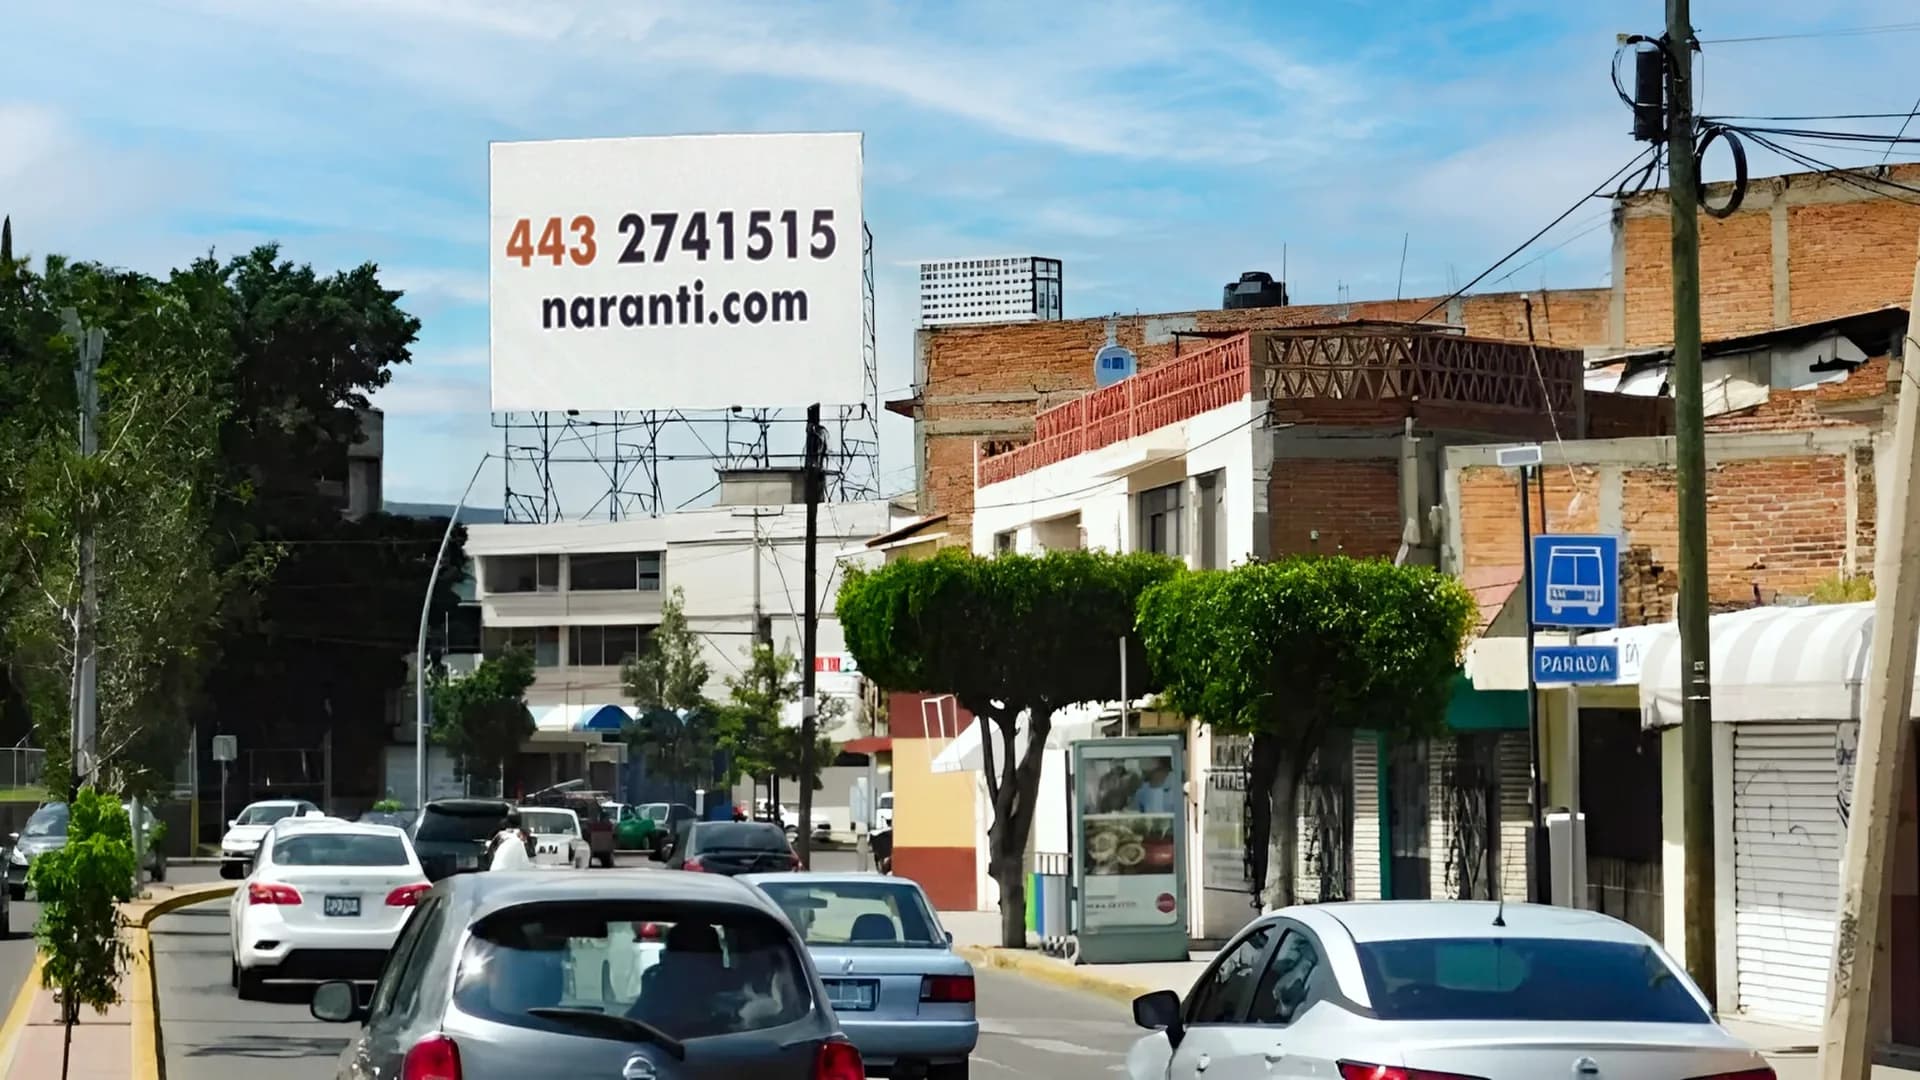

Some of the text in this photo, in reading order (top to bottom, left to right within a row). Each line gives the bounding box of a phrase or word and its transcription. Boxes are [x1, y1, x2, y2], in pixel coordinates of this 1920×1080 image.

[506, 209, 836, 267] 443 2741515
[542, 278, 808, 329] naranti.com
